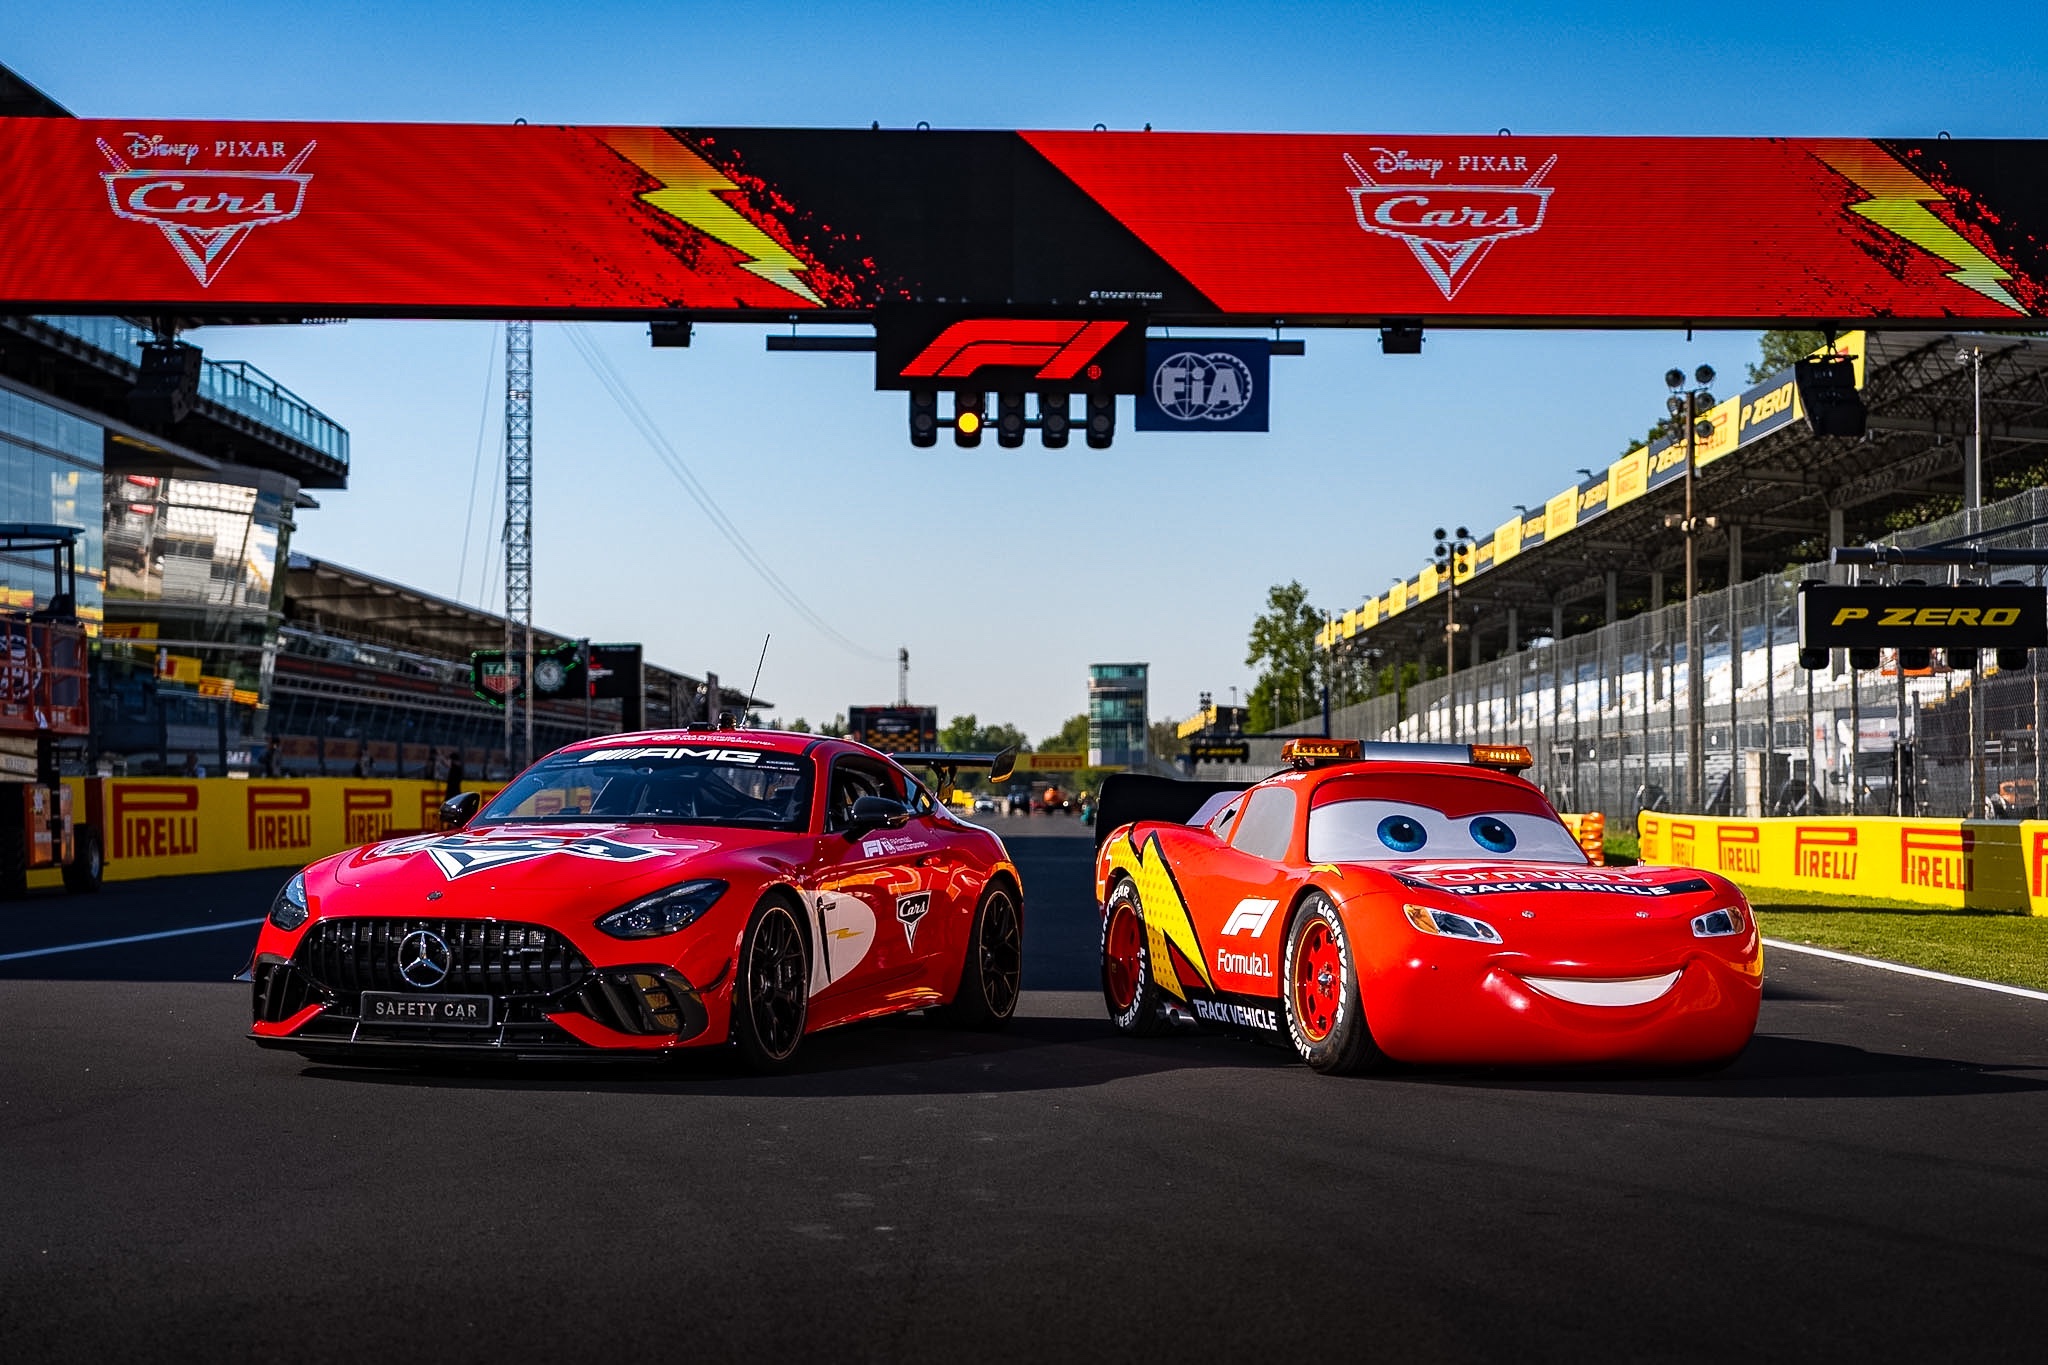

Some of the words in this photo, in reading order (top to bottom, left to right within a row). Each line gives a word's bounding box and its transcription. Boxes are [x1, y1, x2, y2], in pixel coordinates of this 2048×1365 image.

[215, 141, 286, 157] PIXAR
[1458, 156, 1528, 171] PIXAR
[128, 181, 283, 213] Cars
[1374, 196, 1525, 227] Cars
[900, 318, 1128, 379] F1
[1751, 382, 1794, 425] ZERO
[1831, 608, 1869, 626] P
[1878, 608, 2021, 626] ZERO
[632, 748, 761, 764] AMG
[113, 784, 198, 858] PIRELLI
[248, 787, 311, 850] PIRELLI
[1718, 826, 1760, 873] PIRELLI
[1795, 827, 1857, 880] PIRELLI
[1901, 828, 1975, 892] PIRELLI
[1541, 881, 1671, 896] VEHICLE
[899, 900, 926, 918] Cars
[1221, 899, 1280, 938] F1
[1317, 900, 1348, 1024] LIGHTYEAR
[375, 1002, 437, 1017] SAFETY
[444, 1003, 477, 1018] CAR
[1193, 999, 1230, 1023] TRACK
[1229, 1004, 1278, 1031] VEHICLE
